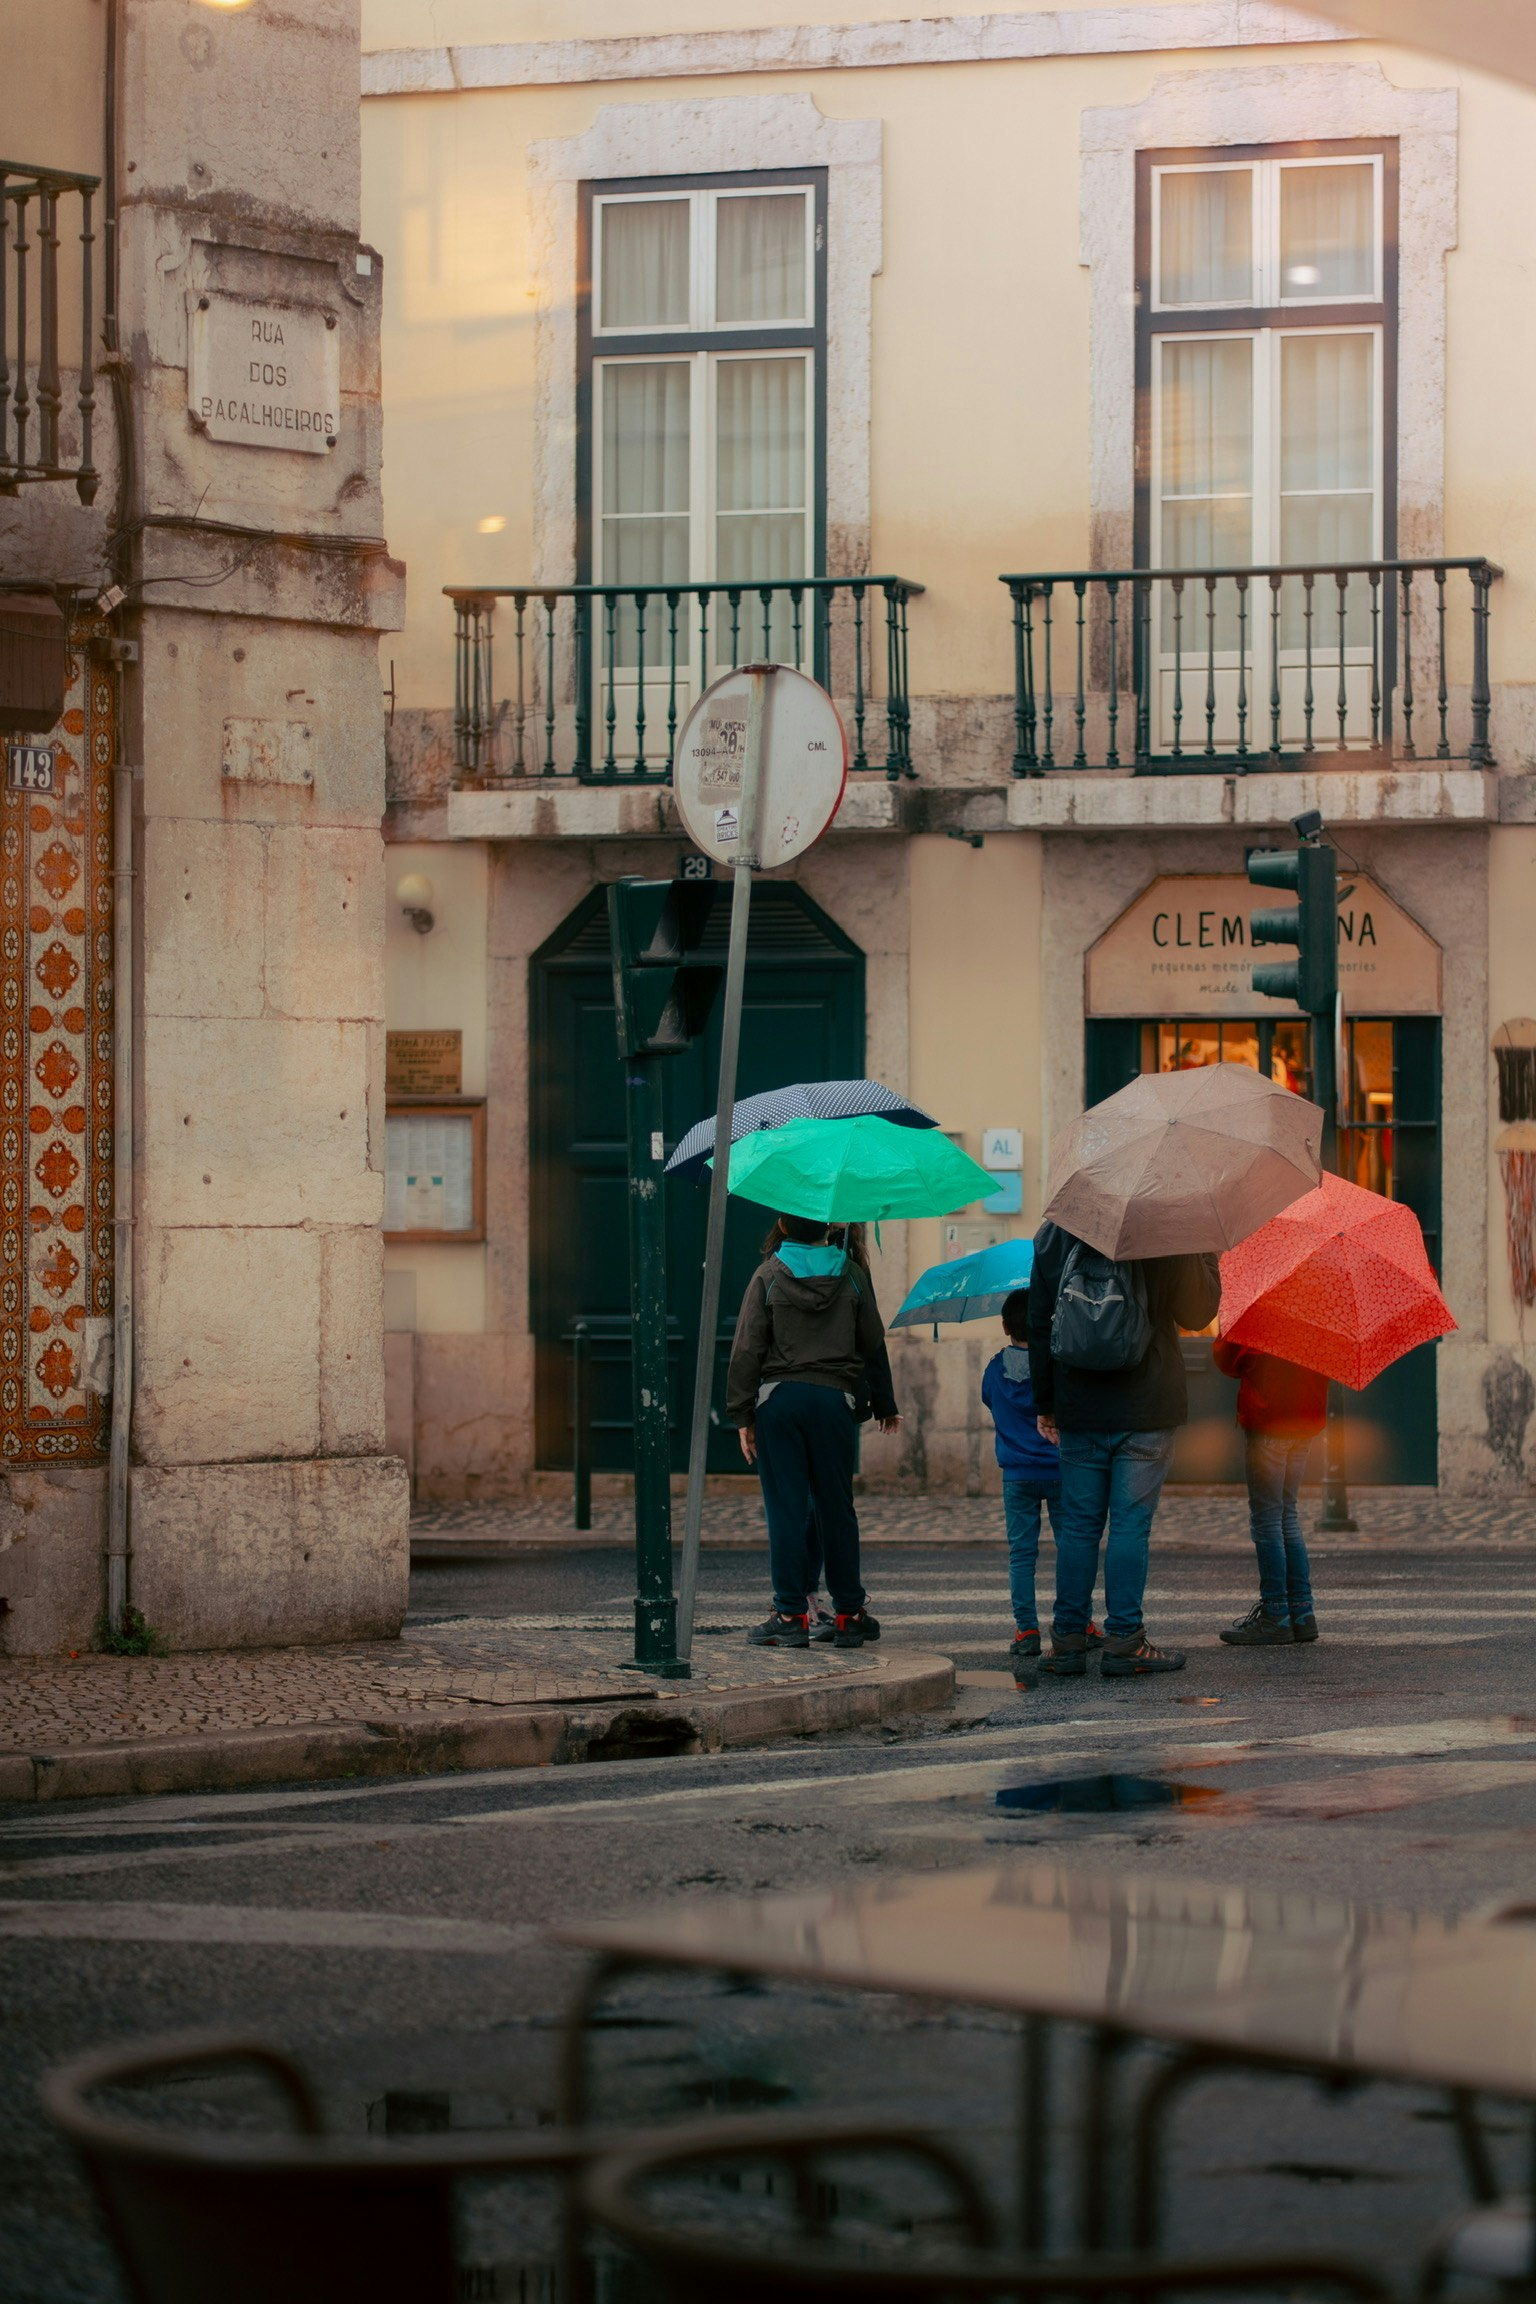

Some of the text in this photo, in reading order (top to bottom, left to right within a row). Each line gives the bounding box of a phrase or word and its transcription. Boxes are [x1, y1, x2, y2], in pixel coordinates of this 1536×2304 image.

[251, 319, 285, 346] RUA
[249, 361, 287, 387] DOS
[201, 396, 335, 434] BACALHOEIROS
[807, 741, 827, 752] CML
[13, 749, 52, 788] 143
[684, 856, 708, 879] 29
[1152, 910, 1378, 948] CLEMNA
[992, 1139, 1014, 1156] AL
